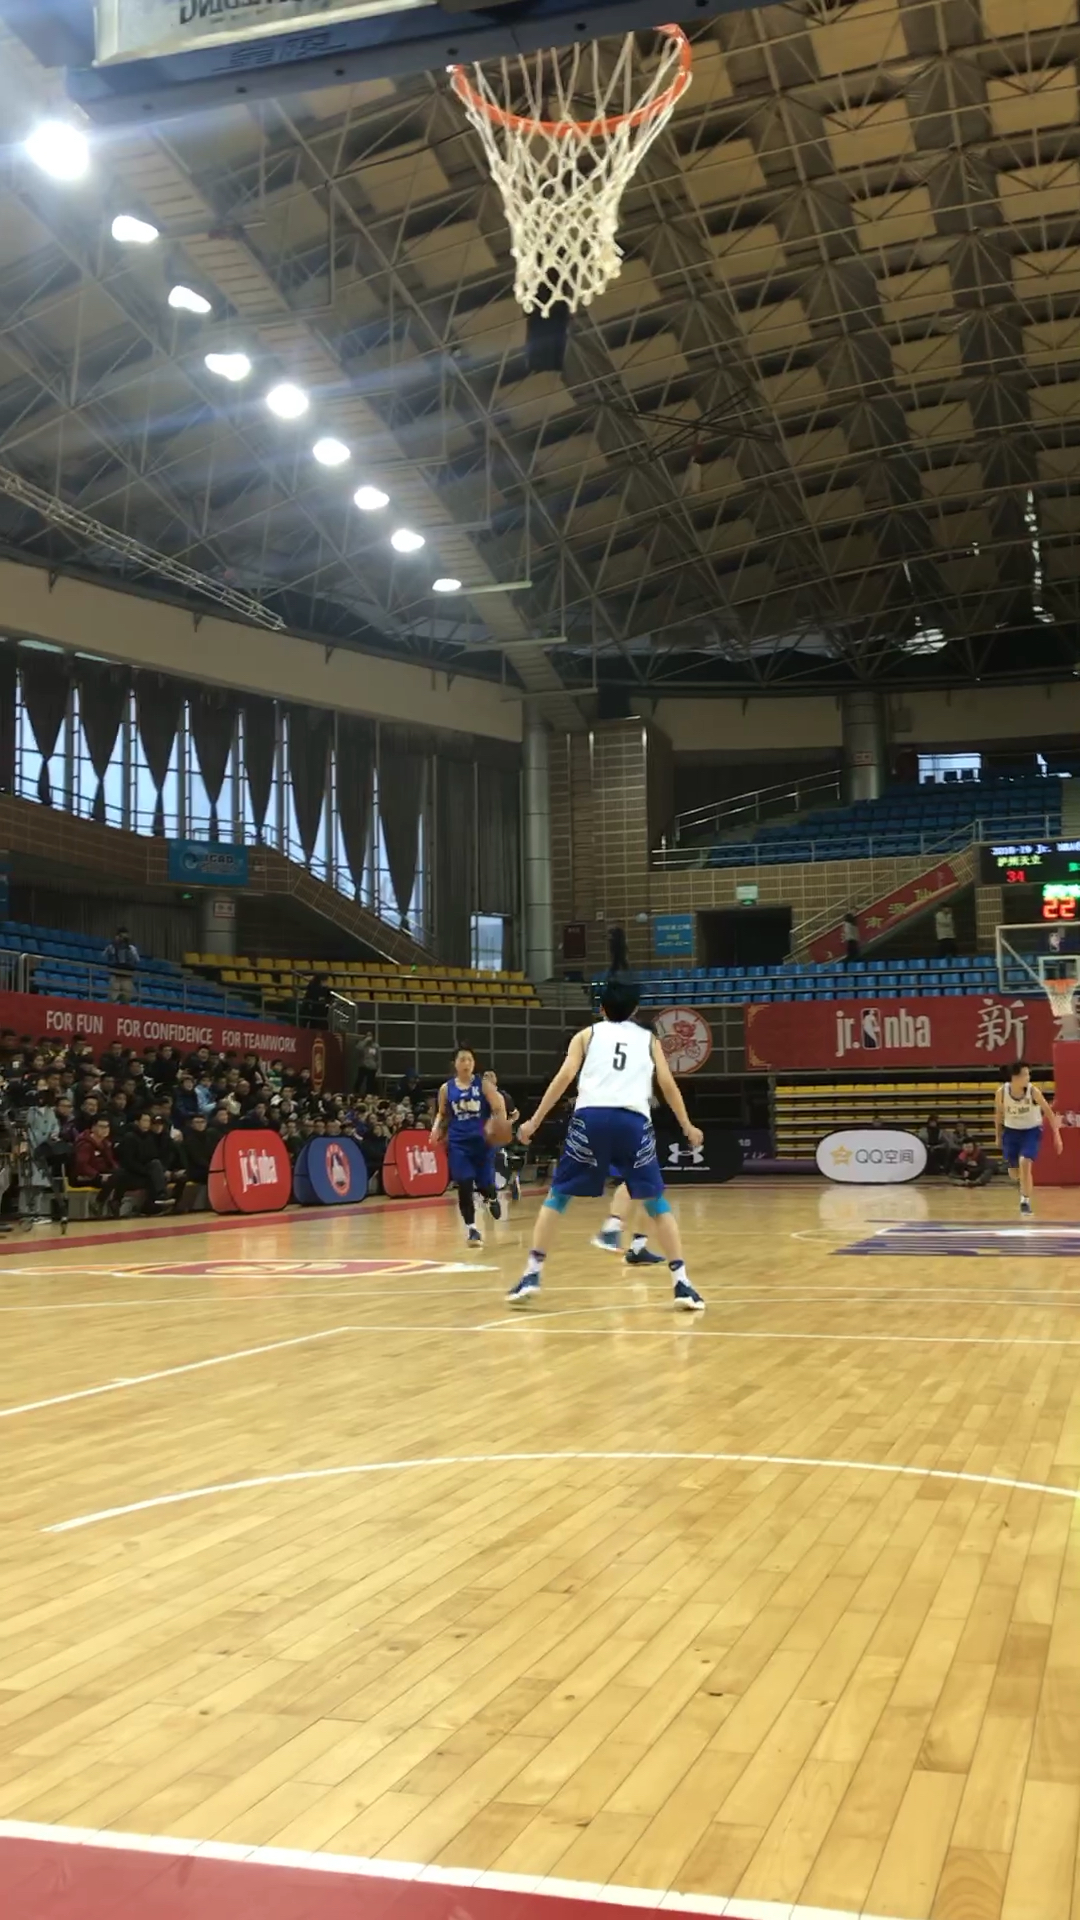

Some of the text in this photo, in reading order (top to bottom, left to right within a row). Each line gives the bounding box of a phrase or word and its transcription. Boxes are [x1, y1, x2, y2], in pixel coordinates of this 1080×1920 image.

[1006, 870, 1025, 883] 34
[1042, 896, 1076, 919] 22
[46, 1010, 296, 1053] FOR FUN FOR CONFIDENCE FOR TEAMWORK
[835, 1008, 931, 1057] jr. nba
[975, 998, 1029, 1062] 新
[613, 1041, 628, 1072] 5
[855, 1149, 914, 1164] QQ空间
